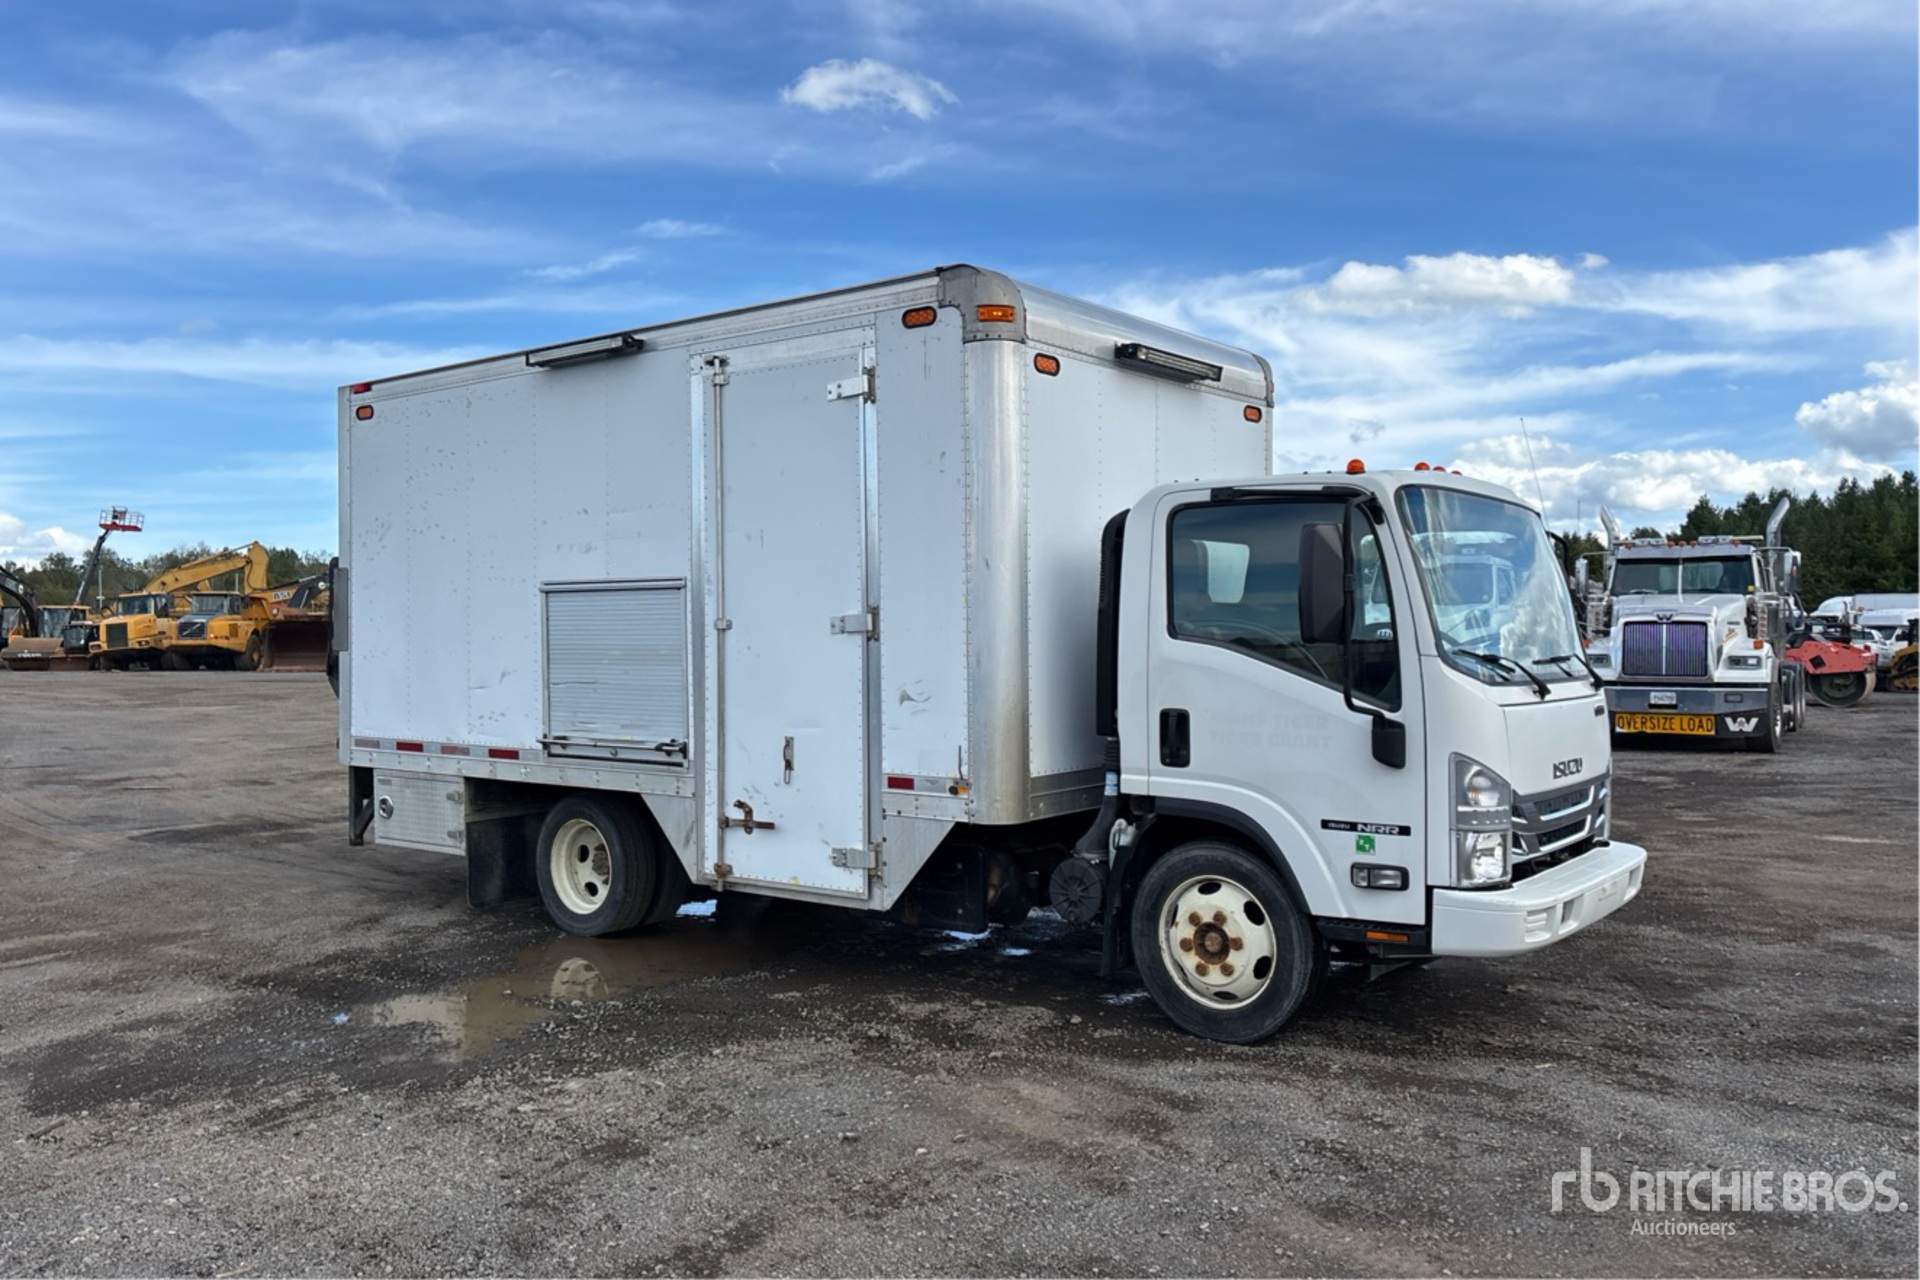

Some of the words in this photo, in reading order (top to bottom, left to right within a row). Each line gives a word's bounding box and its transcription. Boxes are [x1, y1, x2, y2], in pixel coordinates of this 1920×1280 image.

[1617, 715, 1676, 732] OVERSIZE
[1680, 717, 1714, 732] LOAD
[1327, 822, 1351, 830] ISUZU
[1357, 824, 1400, 834] NRR
